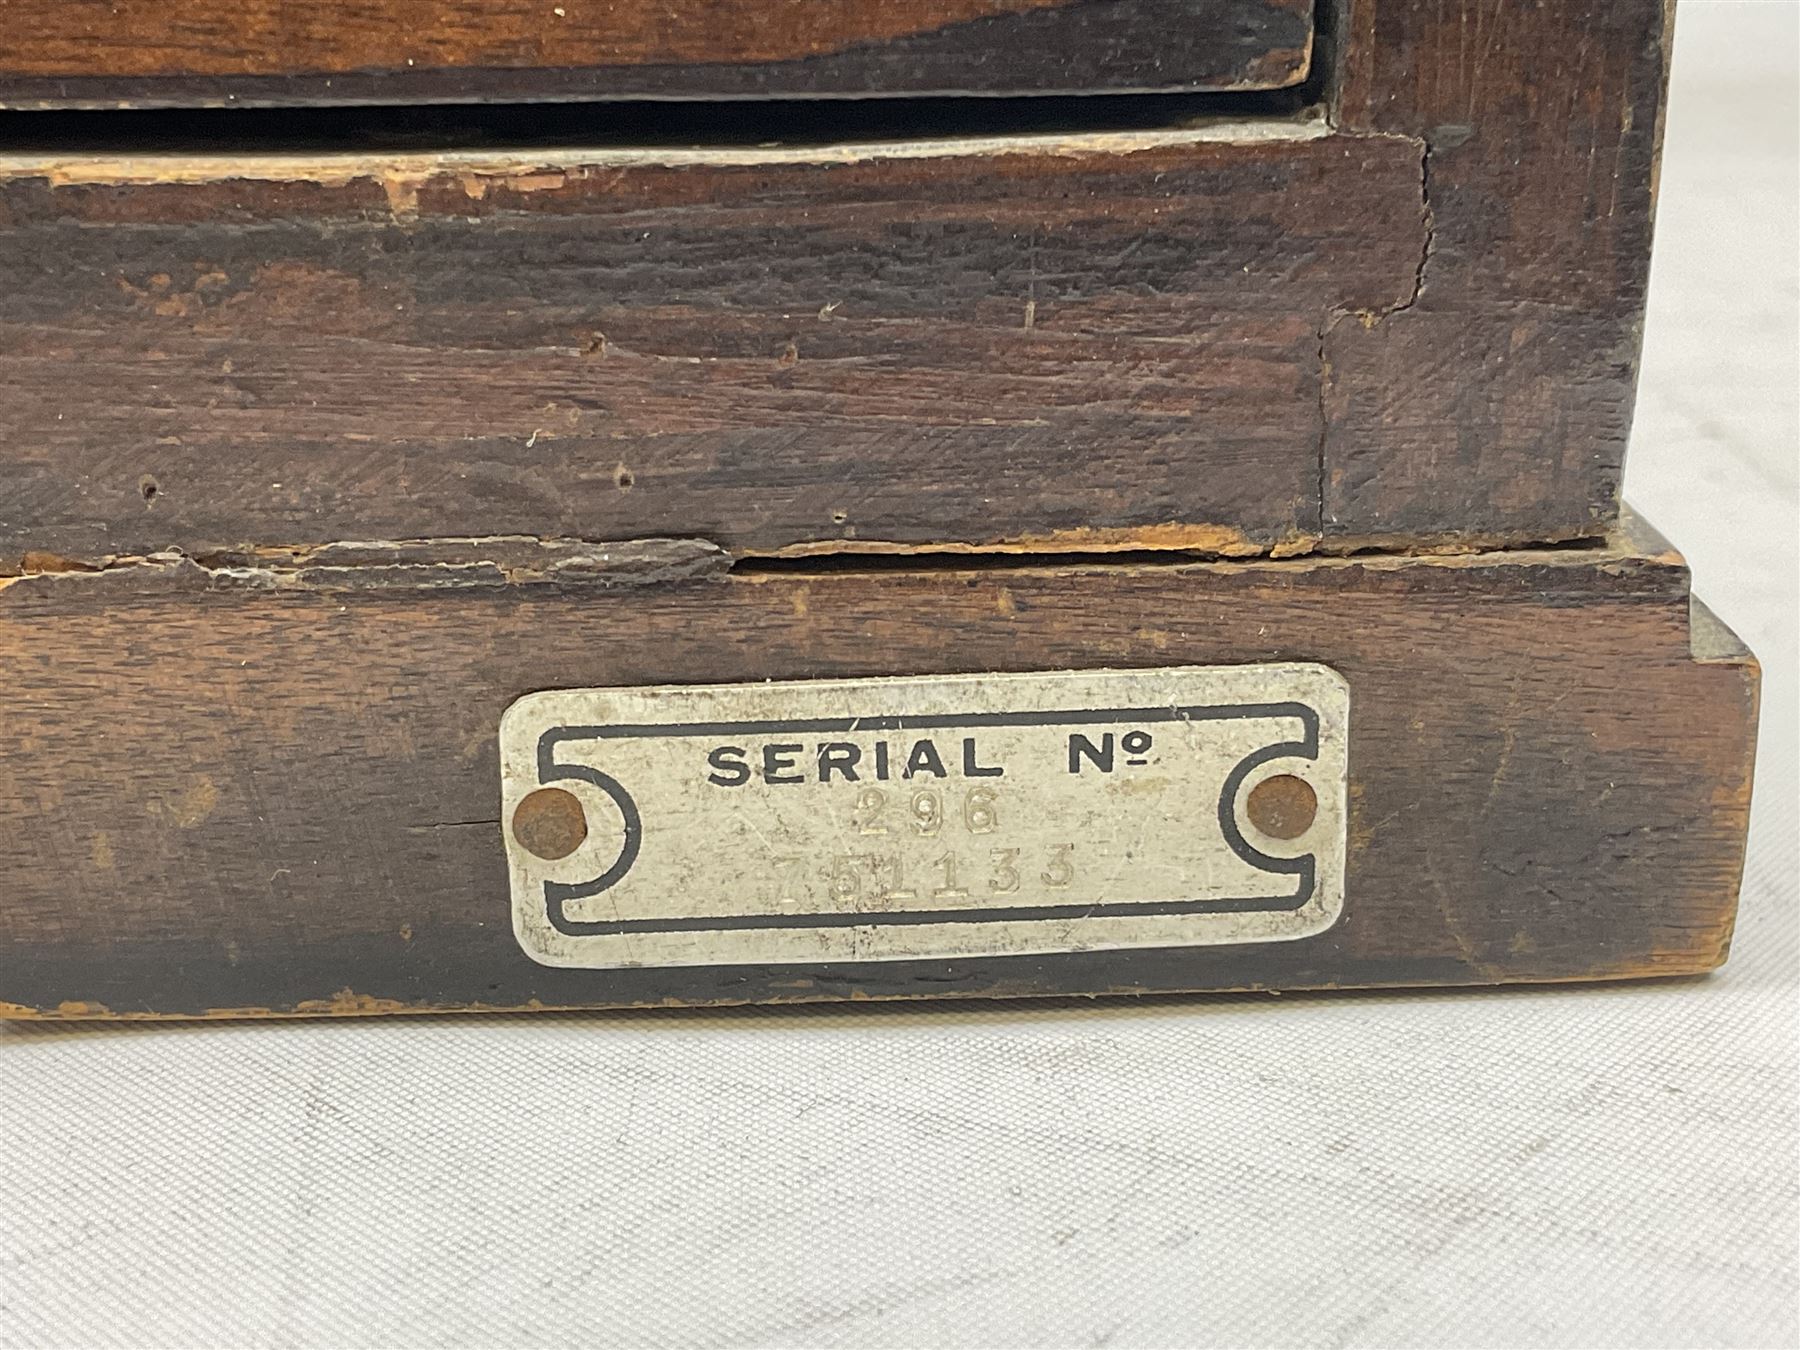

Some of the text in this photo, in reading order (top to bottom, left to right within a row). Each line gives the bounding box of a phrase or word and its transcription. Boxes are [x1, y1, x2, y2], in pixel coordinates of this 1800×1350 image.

[707, 736, 1004, 787] SERIAL
[857, 786, 998, 836] 296
[774, 842, 1075, 902] 751133
